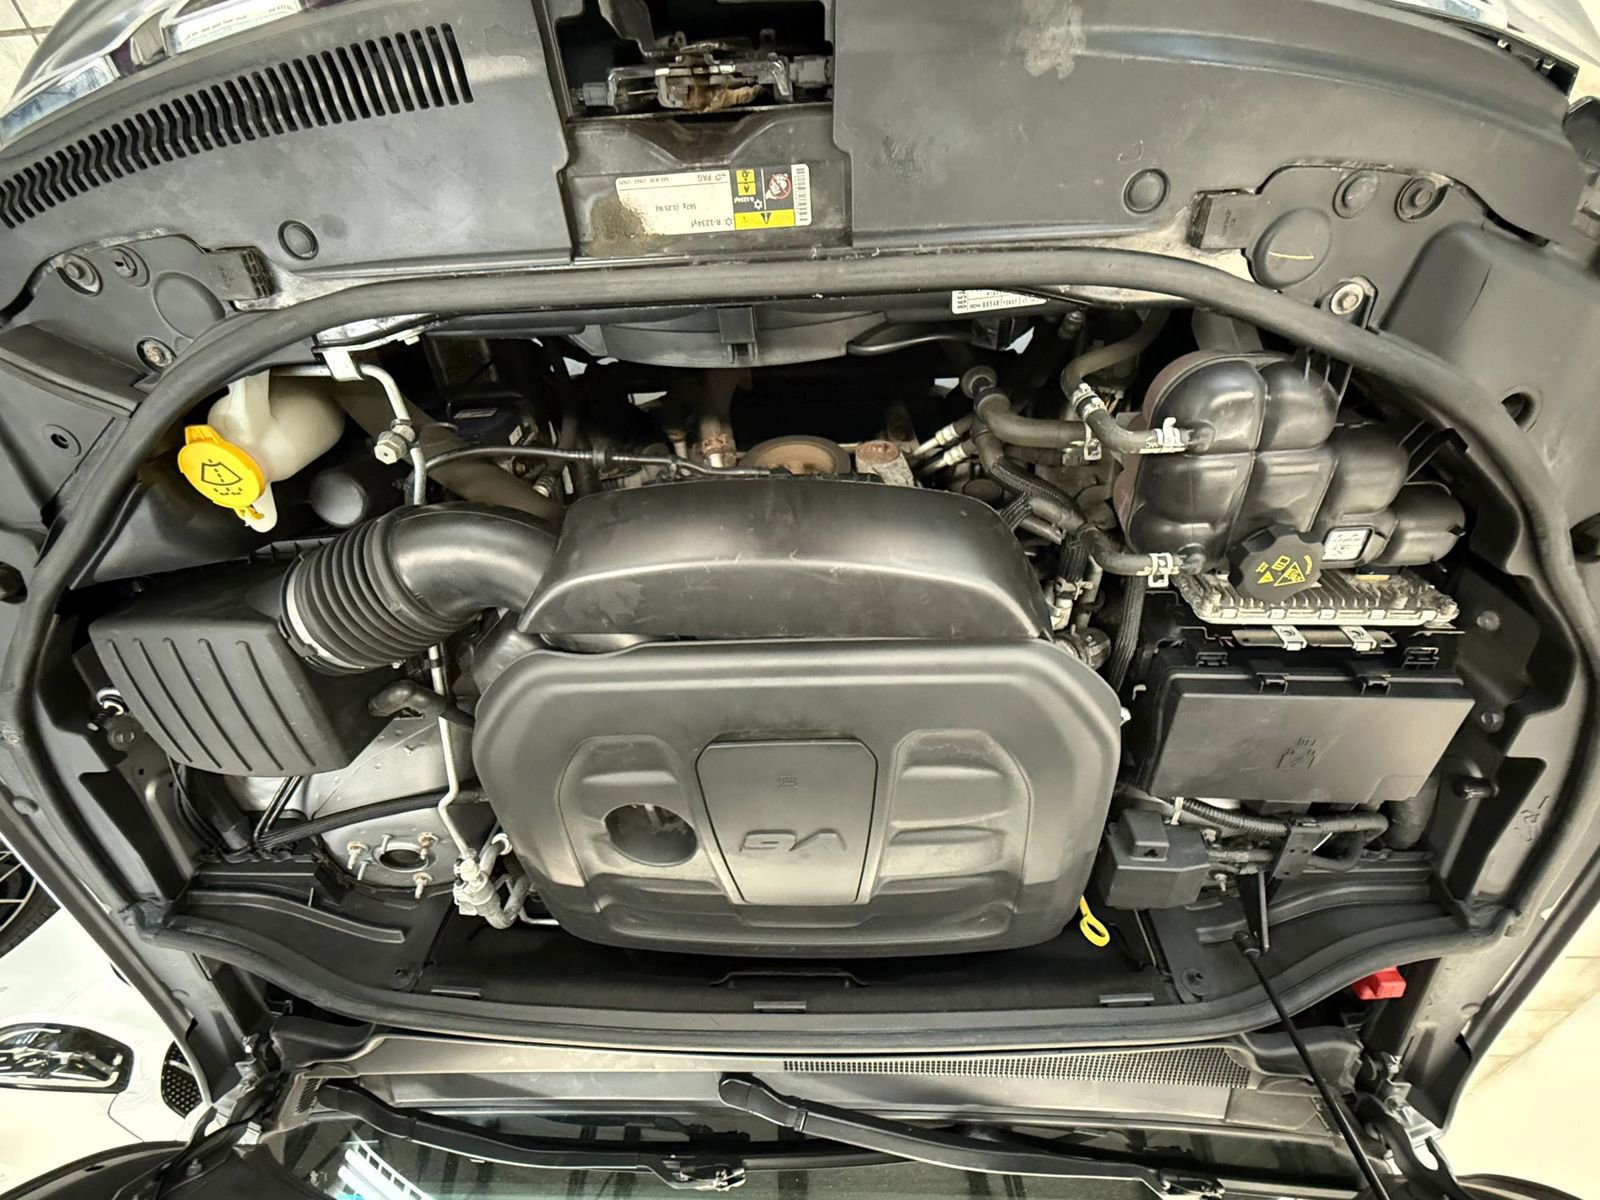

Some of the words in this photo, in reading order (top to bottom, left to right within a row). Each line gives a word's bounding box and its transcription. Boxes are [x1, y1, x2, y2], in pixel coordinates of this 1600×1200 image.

[697, 174, 712, 182] PAG
[691, 218, 721, 228] R-1234yf
[739, 829, 847, 853] V6
